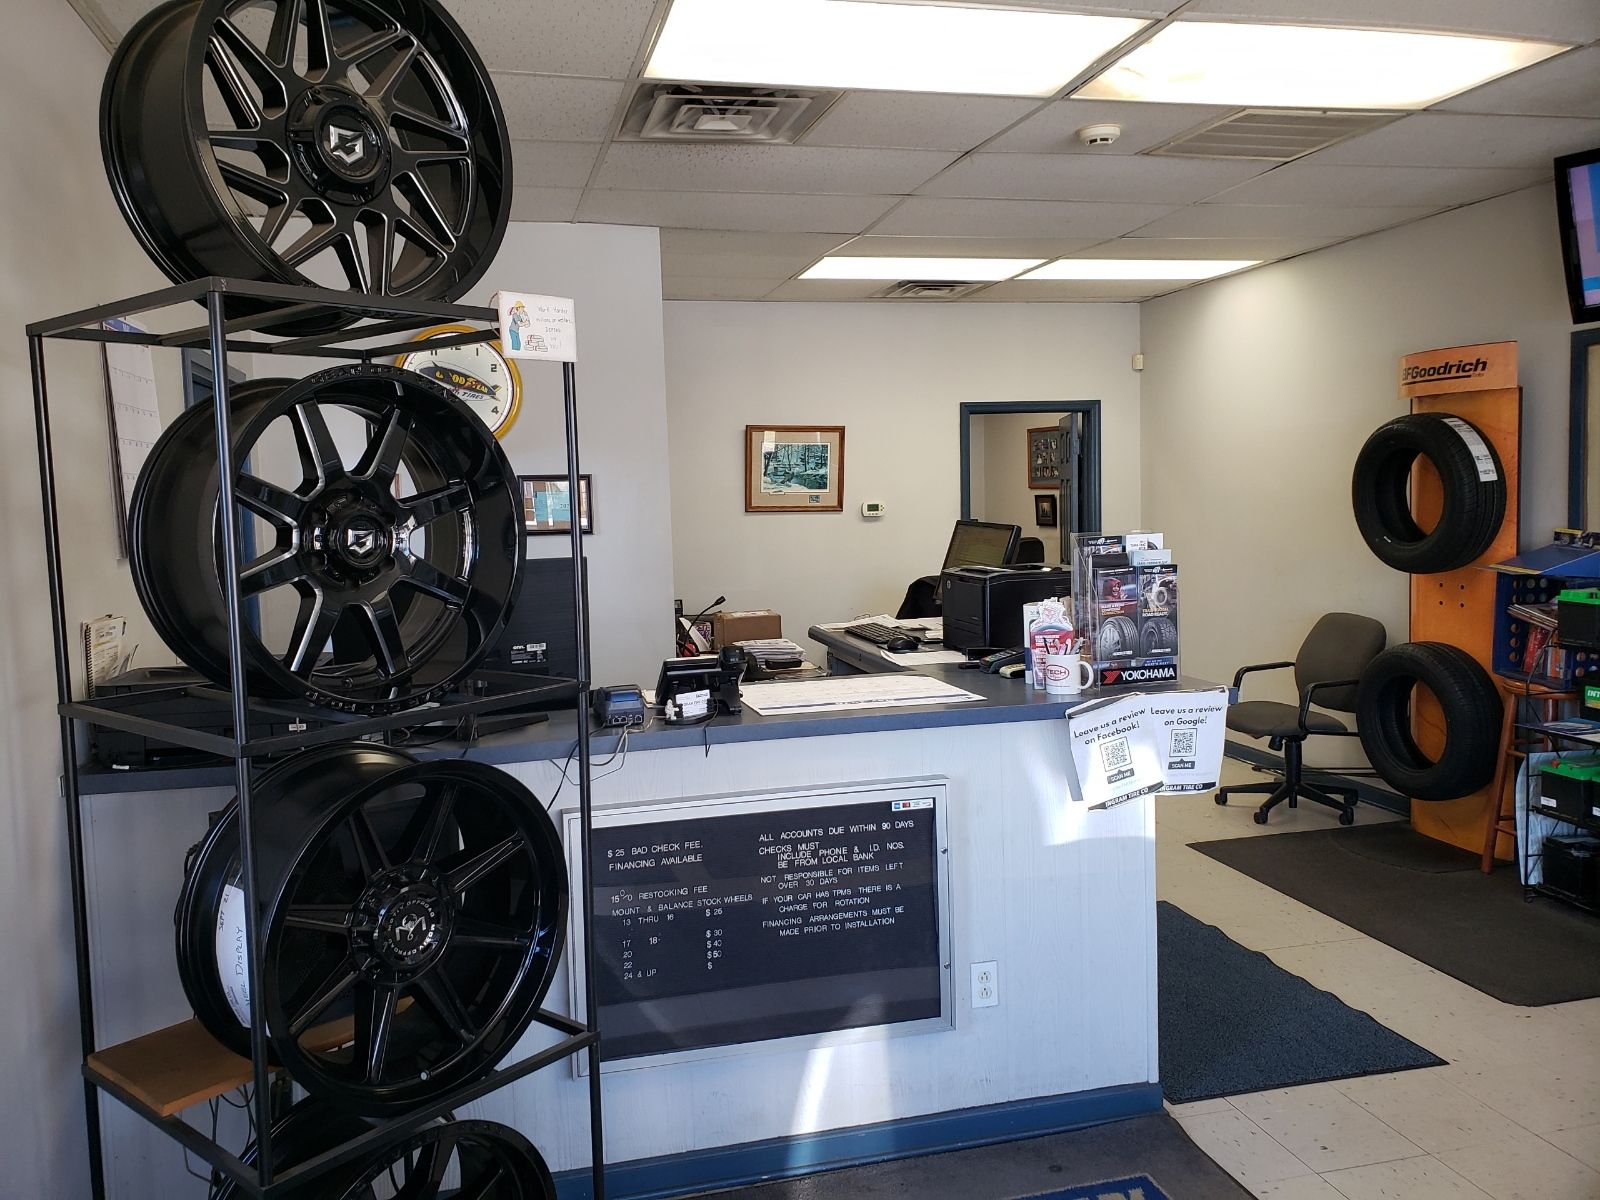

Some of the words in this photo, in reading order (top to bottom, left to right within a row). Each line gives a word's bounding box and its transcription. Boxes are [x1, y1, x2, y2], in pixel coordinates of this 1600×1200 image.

[490, 364, 498, 372] 2
[491, 406, 499, 414] 4
[1120, 667, 1175, 680] YOKOHAMA
[1150, 706, 1176, 715] Leave
[1177, 706, 1187, 714] us
[1195, 704, 1223, 714] review
[1073, 725, 1099, 739] Leave
[1100, 720, 1110, 729] us
[1118, 707, 1146, 723] review
[1176, 716, 1207, 727] Google!
[1084, 736, 1096, 745] on
[1097, 720, 1140, 742] Facebook!
[1110, 773, 1124, 783] SCAN
[1123, 770, 1132, 779] ME
[1105, 794, 1128, 808] INGRAM
[1140, 787, 1149, 795] CO
[759, 834, 774, 842] ALL
[780, 828, 824, 840] ACCOUNTS
[828, 826, 845, 835] DUE
[849, 824, 877, 833] WITHIN
[881, 822, 891, 830] 90
[895, 820, 914, 829] DAYS
[631, 846, 648, 855] BAD
[651, 842, 680, 853] CHECK
[684, 840, 704, 850] FEE.
[759, 844, 792, 855] CHECKS
[798, 842, 820, 851] MUST
[777, 851, 812, 861] INCLUDE
[819, 847, 848, 857] PHONE
[609, 859, 656, 871] FINANCING
[660, 854, 703, 866] AVAILABLE
[778, 861, 788, 869] BE
[794, 858, 818, 867] FROM
[822, 854, 848, 864] LOCAL
[853, 852, 874, 862] BANK
[760, 875, 777, 884] NOT
[784, 869, 833, 881] RESPONSIBLE
[837, 867, 853, 875] FOR
[858, 865, 880, 873] ITEMS
[886, 862, 903, 871] LEFT
[778, 881, 799, 890] OVER
[805, 879, 815, 887] 30
[819, 876, 838, 885] DAYS
[638, 887, 689, 900] RESTOCKING
[693, 885, 708, 893] FEE
[762, 897, 769, 905] IF
[773, 894, 793, 903] YOUR
[797, 892, 812, 901] CAR
[815, 890, 830, 898] HAS
[832, 887, 852, 897] TPMS
[858, 885, 882, 894] THERE
[885, 883, 893, 891] IS
[895, 882, 902, 891] A
[612, 906, 641, 917] MOUNT
[658, 900, 693, 911] BALANCE
[697, 896, 722, 907] STOCK
[724, 893, 753, 904] WHEELS
[779, 904, 808, 913] CHARGE
[813, 901, 828, 909] FOR
[834, 897, 870, 907] ROTATION
[638, 916, 659, 925] THRU
[762, 917, 803, 928] FINANCING
[809, 910, 868, 923] ARRANGEMENTS
[871, 907, 891, 916] MUST
[894, 905, 905, 913] BE
[779, 928, 799, 937] MADE
[804, 925, 828, 934] PRIOR
[831, 923, 841, 931] TO
[845, 917, 895, 930] INSTALLATION
[236, 926, 244, 975] DISPLAY
[622, 940, 631, 948] 17
[623, 961, 633, 969] 22
[624, 972, 633, 980] 24
[646, 969, 657, 977] UP
